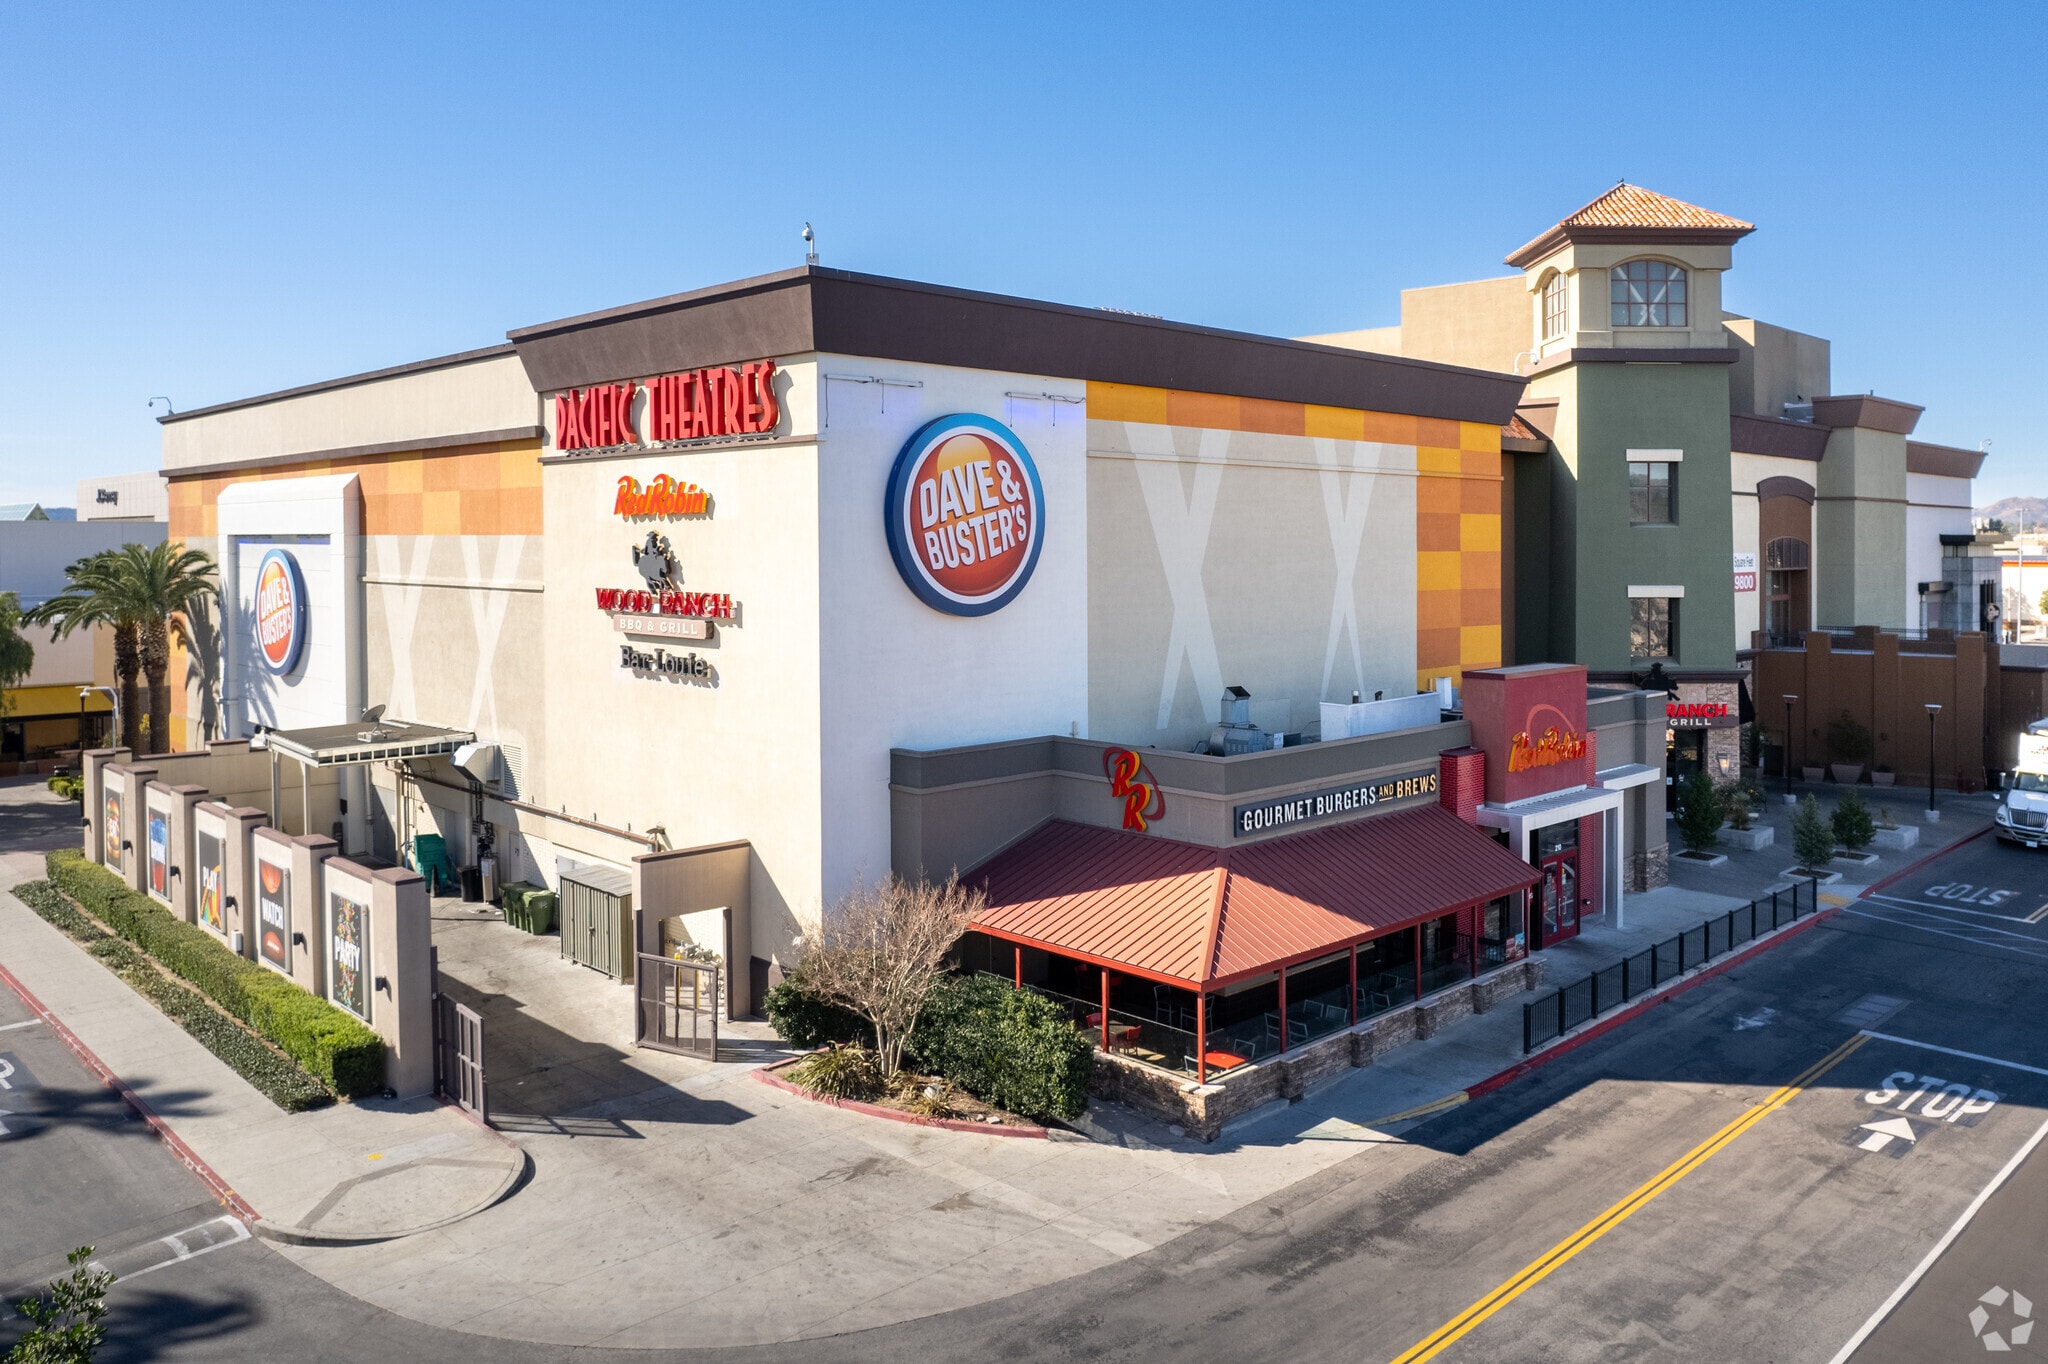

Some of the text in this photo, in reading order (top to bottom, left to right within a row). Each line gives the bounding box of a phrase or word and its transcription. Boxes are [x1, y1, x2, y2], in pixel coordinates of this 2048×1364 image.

[555, 360, 778, 450] PACIFIC THEATRES
[920, 459, 1024, 529] DAVE &
[924, 504, 1027, 570] BUSTER'S
[261, 576, 291, 619] DAVE &
[595, 588, 731, 618] WOOD RANCH
[619, 618, 698, 635] BBQ & GRILL
[620, 644, 708, 678] Bar Louie
[1665, 702, 1728, 718] RANCH
[1669, 718, 1712, 726] GRILL
[1243, 773, 1437, 831] GOURMET BURGERS AND BREWS
[1924, 882, 2012, 906] STOP
[262, 897, 284, 930] WATCH
[334, 935, 360, 972] PARTY
[1864, 1071, 2000, 1123] STOP
